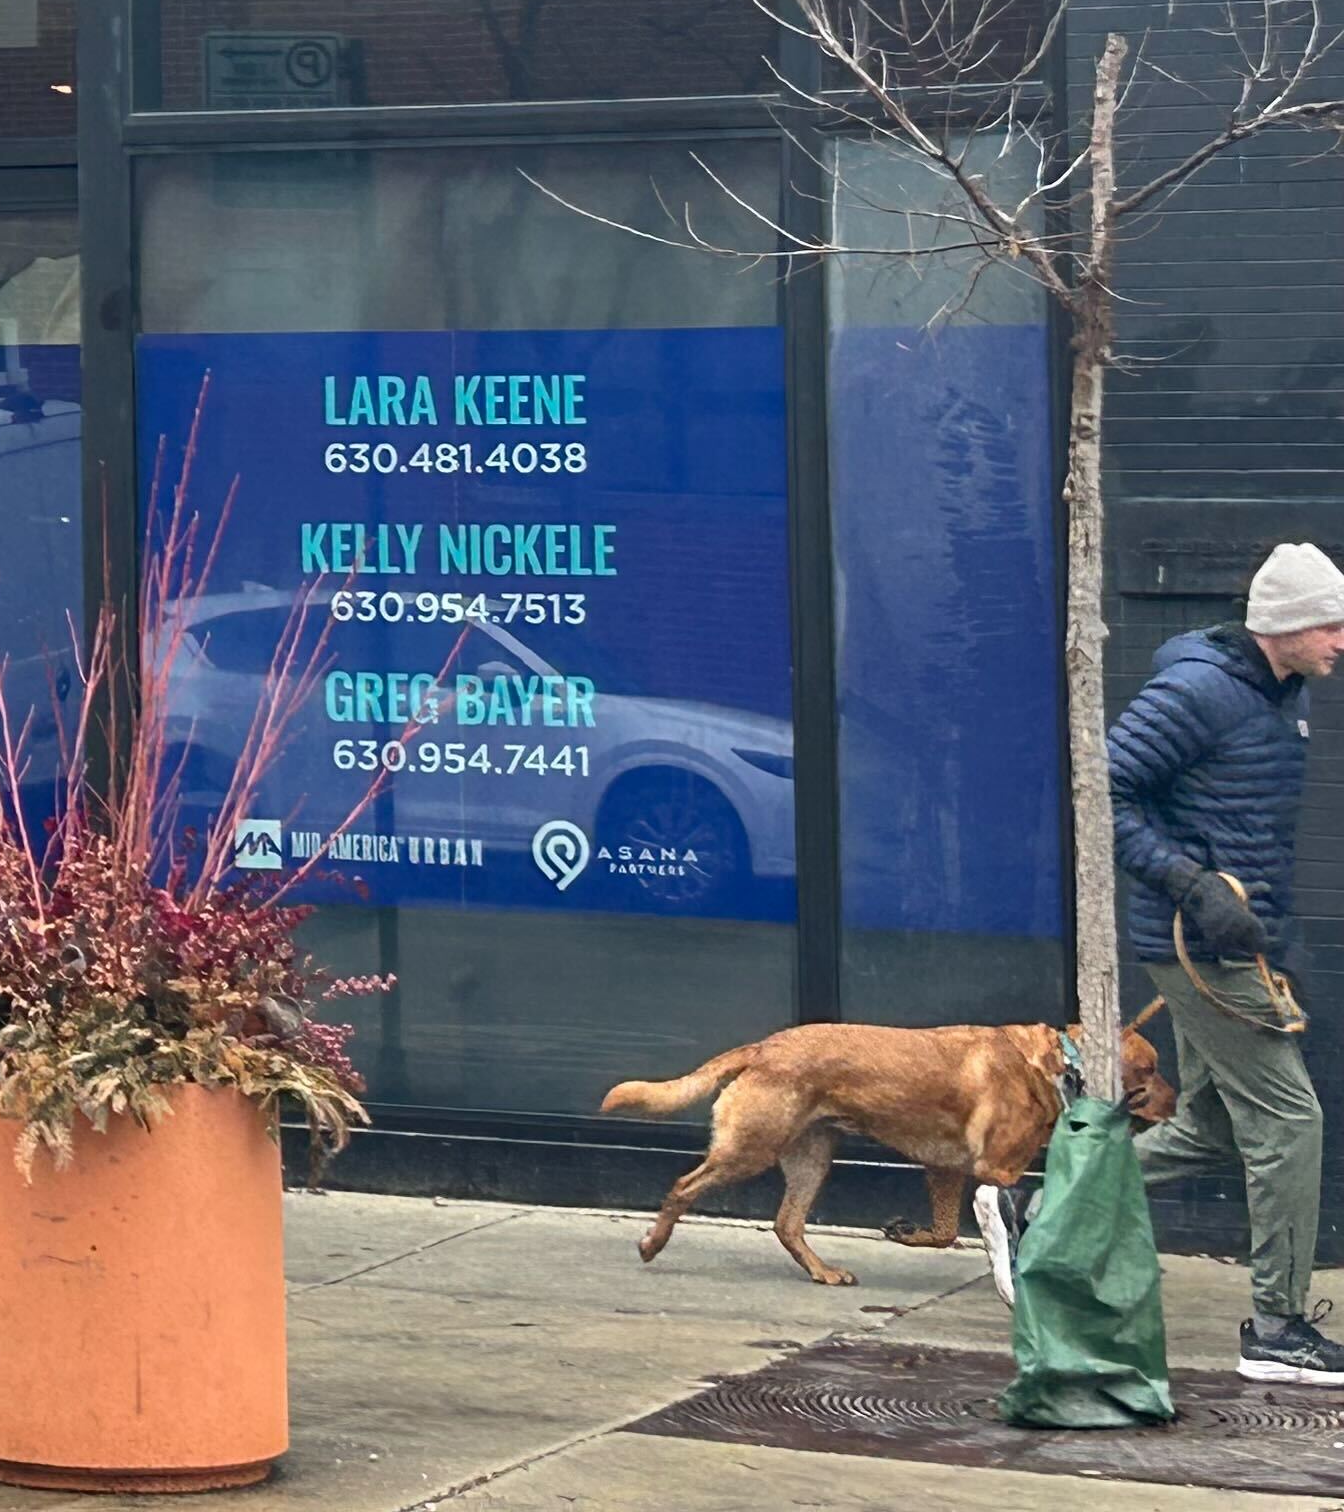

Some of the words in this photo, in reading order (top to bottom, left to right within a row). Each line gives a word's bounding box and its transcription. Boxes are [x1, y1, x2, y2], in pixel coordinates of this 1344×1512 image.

[324, 375, 438, 426] LARA
[454, 375, 588, 426] KEENE
[324, 443, 588, 474] 630.481.4038
[300, 522, 424, 576] KELLY
[439, 523, 619, 577] NICKELE
[330, 591, 587, 625] 630.954.7513
[325, 670, 439, 725] GREG
[456, 674, 597, 729] BAYER
[333, 739, 591, 778] 630.954.7441
[408, 836, 486, 867] URBAN
[597, 845, 699, 862] ASANA
